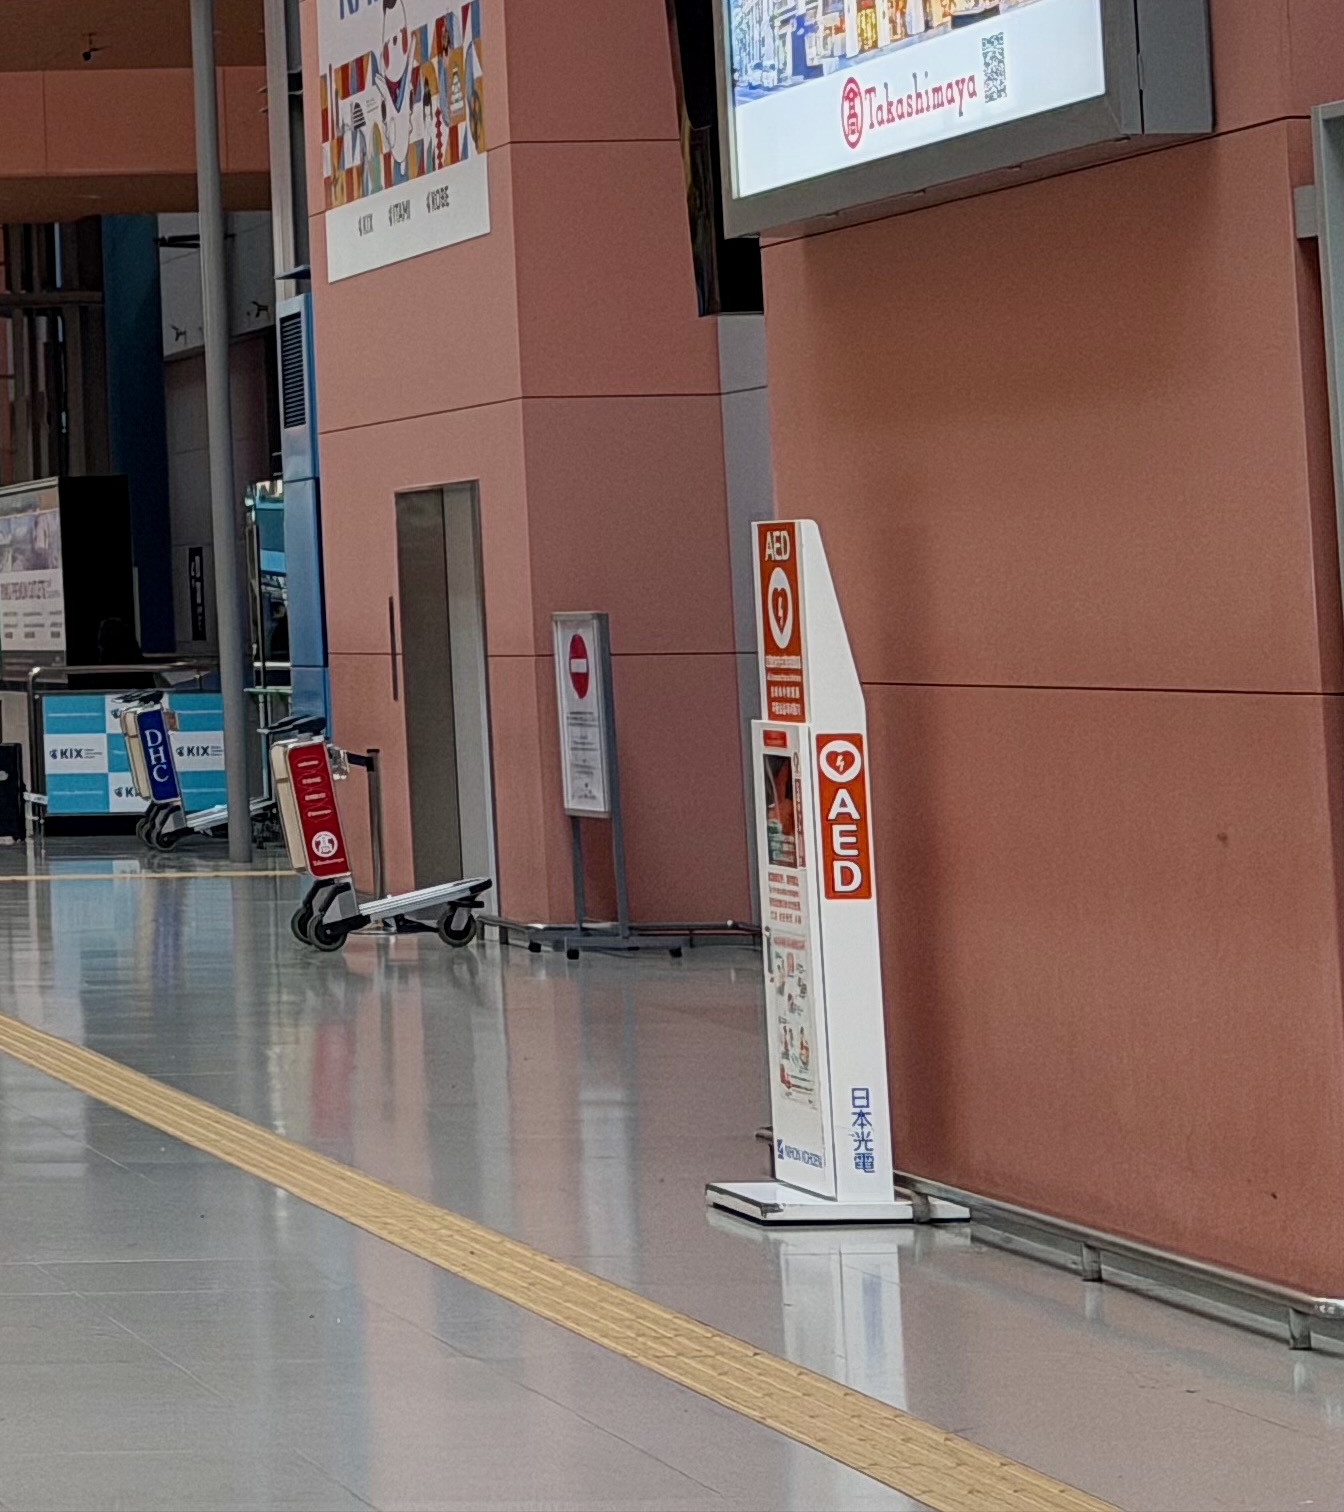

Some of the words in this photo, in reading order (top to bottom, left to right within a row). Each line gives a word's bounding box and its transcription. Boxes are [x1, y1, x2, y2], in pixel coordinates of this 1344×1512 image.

[865, 72, 977, 131] Takashimaya
[765, 531, 790, 562] AED
[60, 748, 83, 759] KIX
[144, 729, 169, 783] DHC
[186, 745, 210, 756] KIX
[827, 788, 862, 892] AED
[851, 1087, 876, 1174] 日本光電
